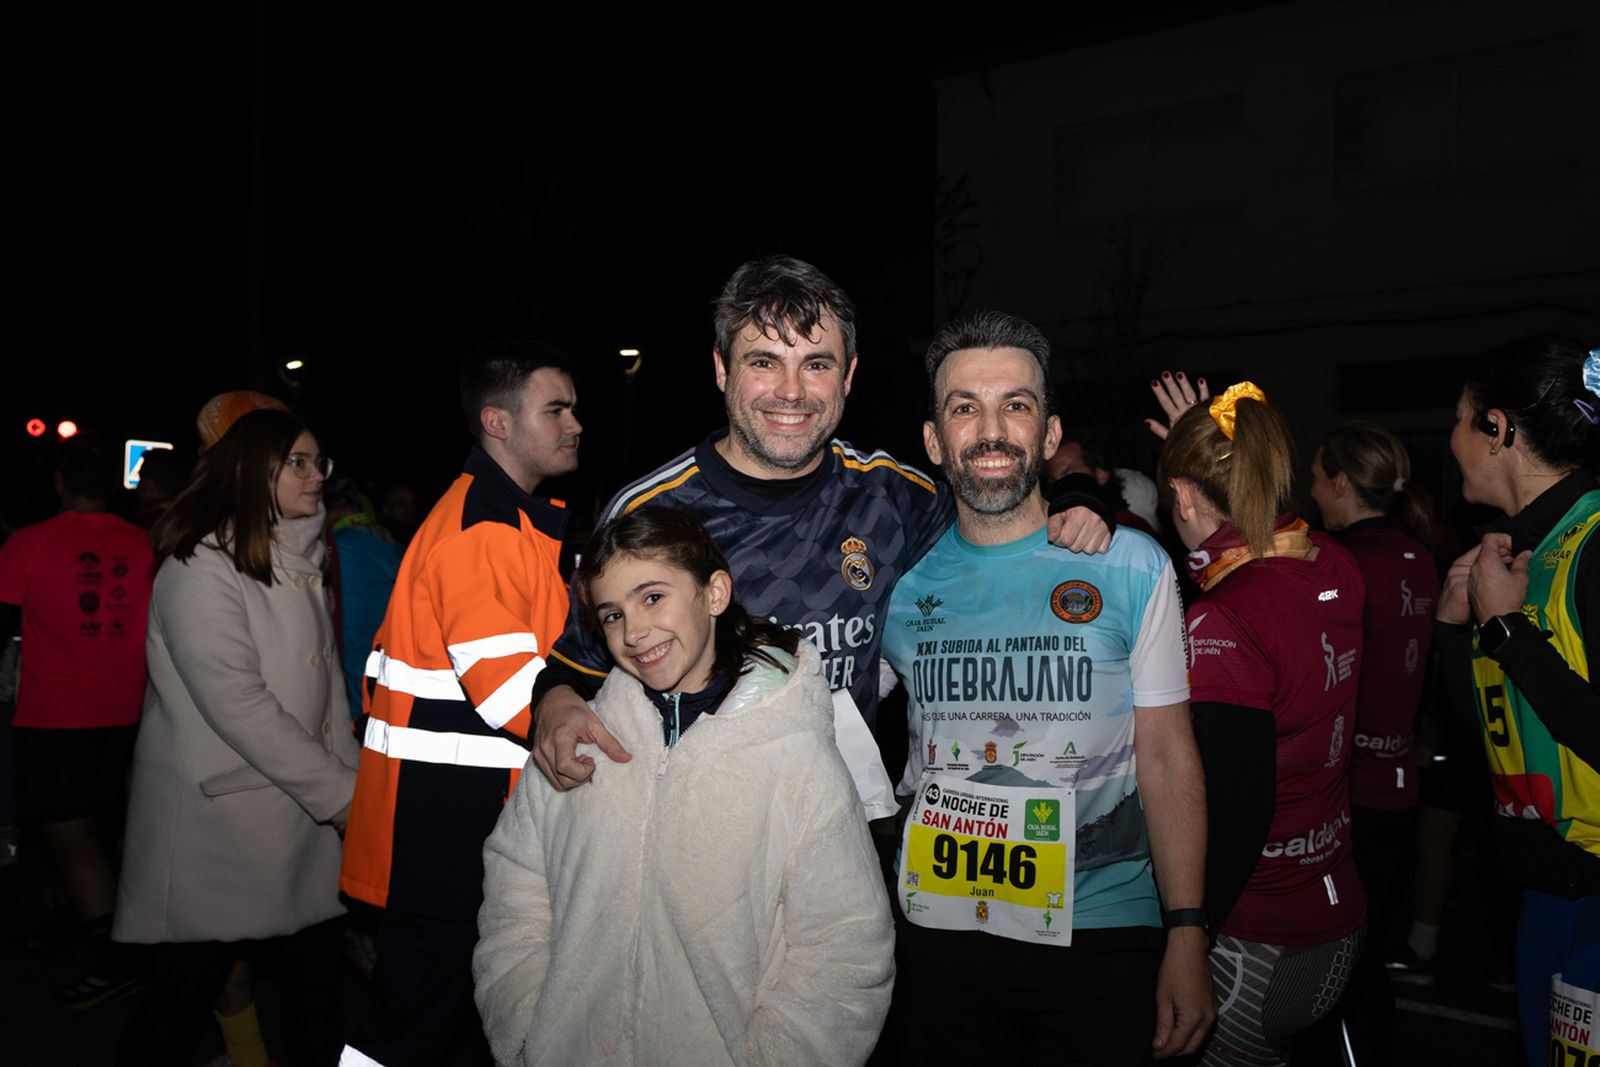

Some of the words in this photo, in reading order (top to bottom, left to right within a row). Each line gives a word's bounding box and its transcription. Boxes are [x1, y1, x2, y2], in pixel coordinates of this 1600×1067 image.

[916, 640, 937, 656] XXI
[941, 638, 982, 653] SUBIDA
[986, 637, 1001, 653] AL
[1005, 635, 1059, 652] PANTANO
[1064, 636, 1087, 652] DEL
[822, 656, 855, 690] TER
[912, 655, 1093, 709] QUIEBRAJANO
[948, 712, 967, 721] UNA
[969, 711, 1012, 721] CARRERA,
[1016, 711, 1037, 721] UNA
[1039, 710, 1092, 722] TRADICIÓN
[926, 787, 938, 801] 43
[941, 794, 986, 816] NOCHE
[989, 803, 1009, 819] DE
[922, 810, 951, 830] SAN
[953, 817, 1008, 839] ANTÓN
[932, 833, 1037, 890] 9146
[970, 886, 994, 896] Juan
[1573, 1006, 1592, 1025] DE
